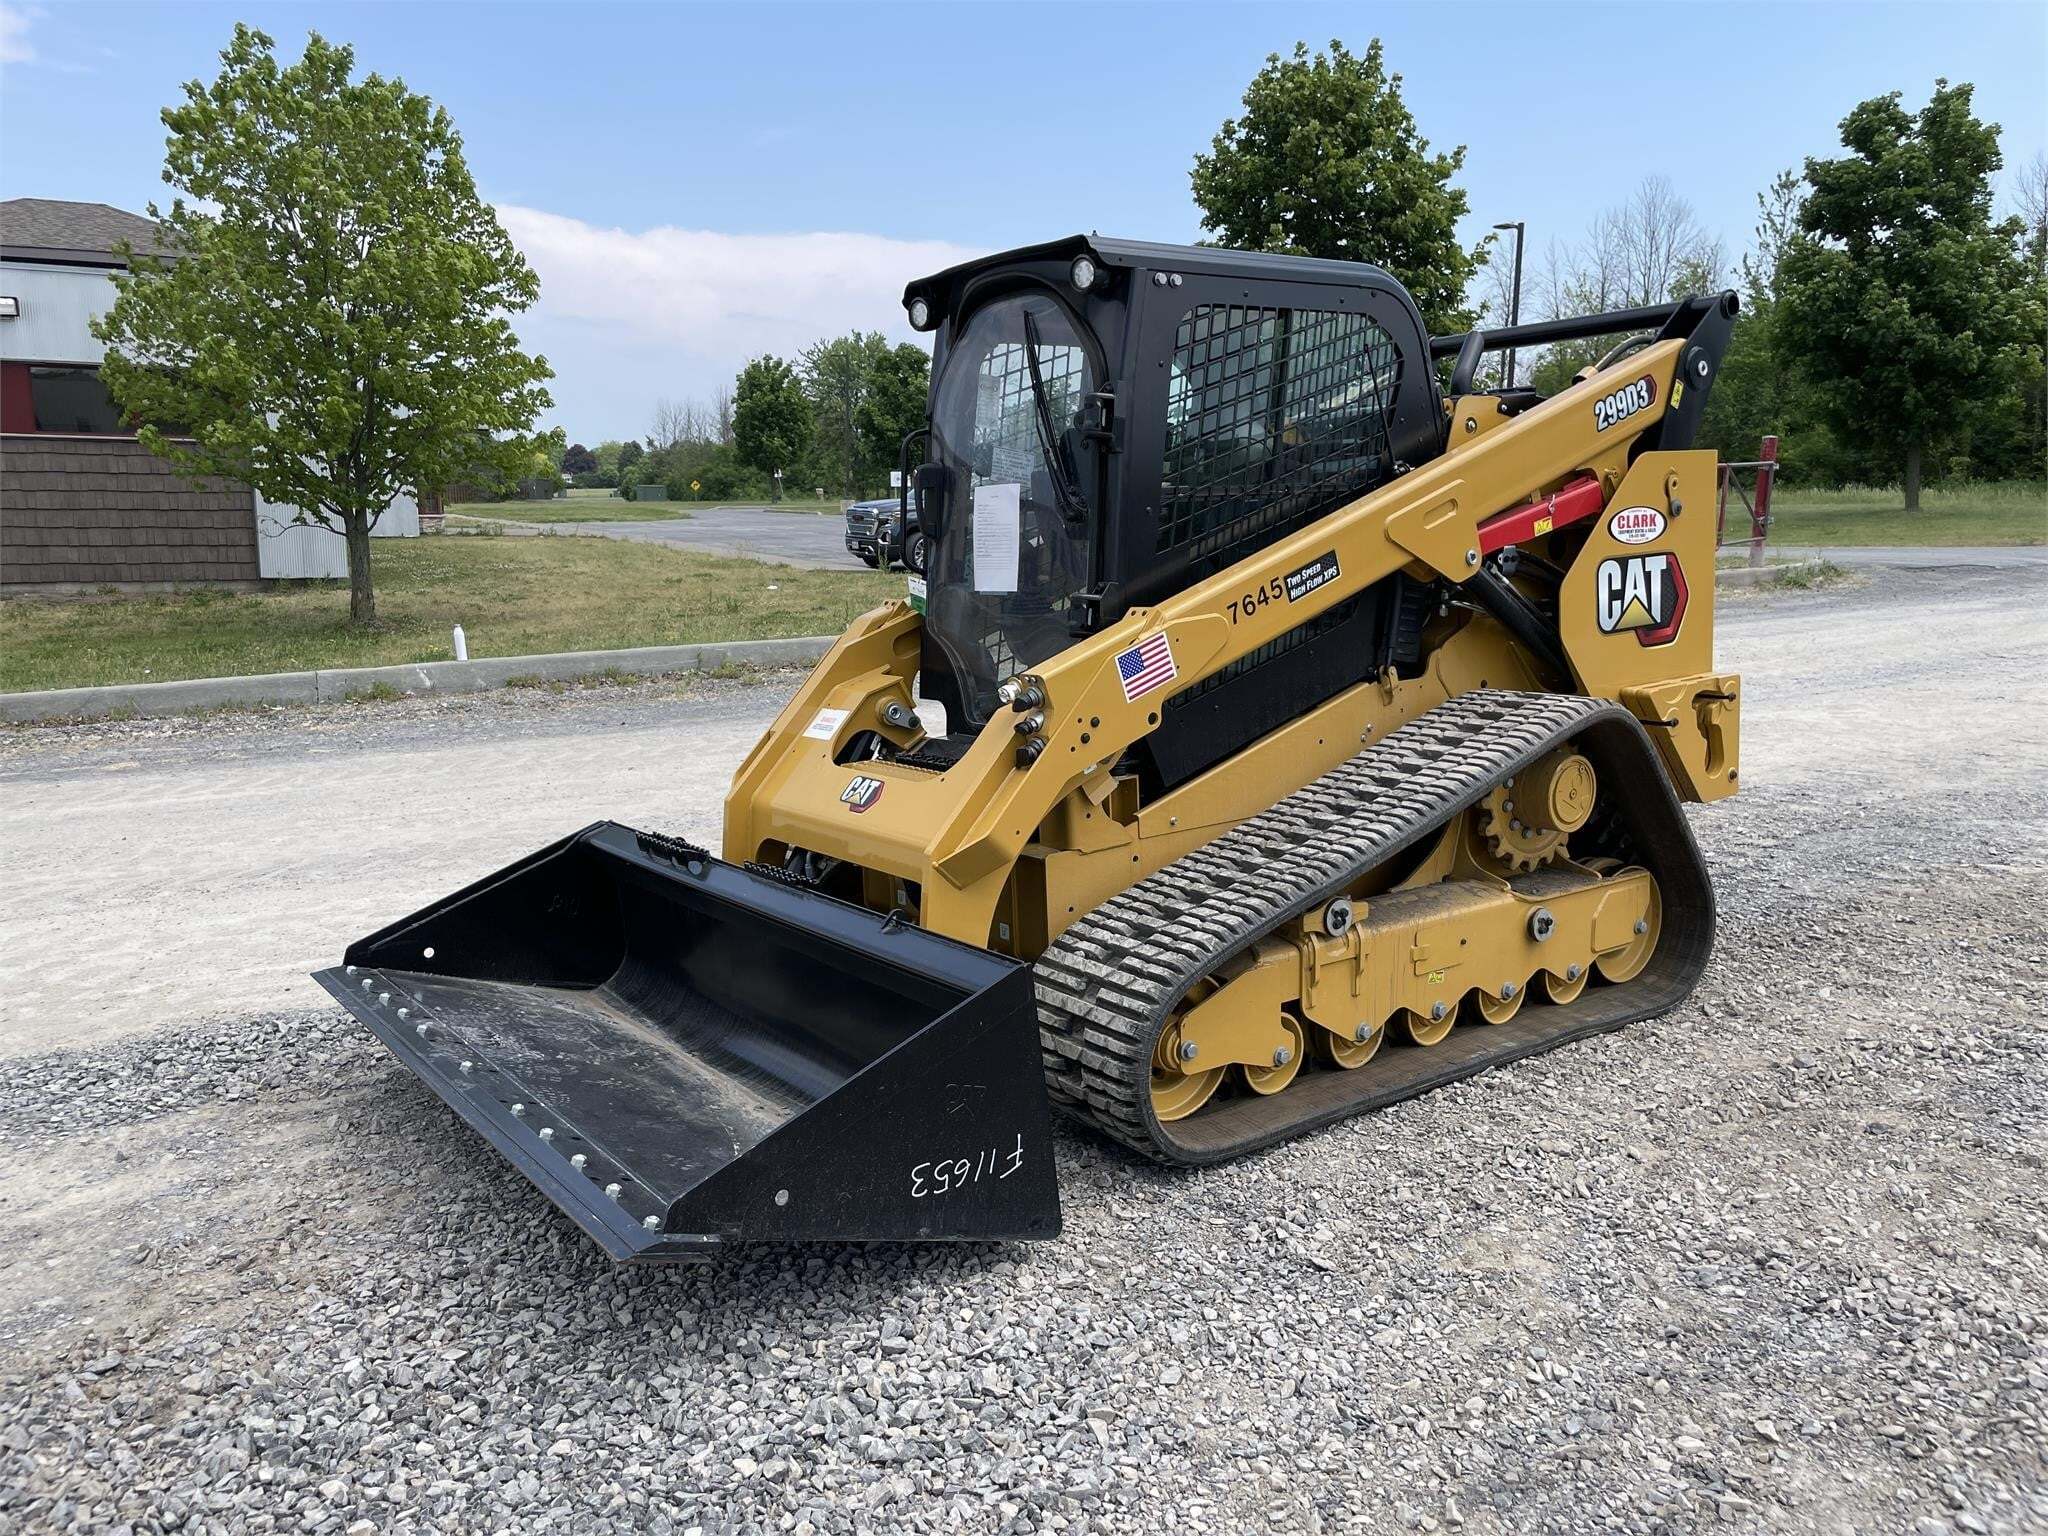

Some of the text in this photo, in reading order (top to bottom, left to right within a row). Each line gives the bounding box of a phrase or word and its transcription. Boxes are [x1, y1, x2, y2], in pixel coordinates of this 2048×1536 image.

[1594, 378, 1649, 432] 299D3
[1617, 513, 1657, 529] CLARK
[1324, 566, 1337, 581] XPS
[1598, 555, 1667, 632] CAT
[1226, 577, 1283, 625] 7645
[842, 776, 880, 805] CAT
[911, 1133, 1024, 1198] F11653
